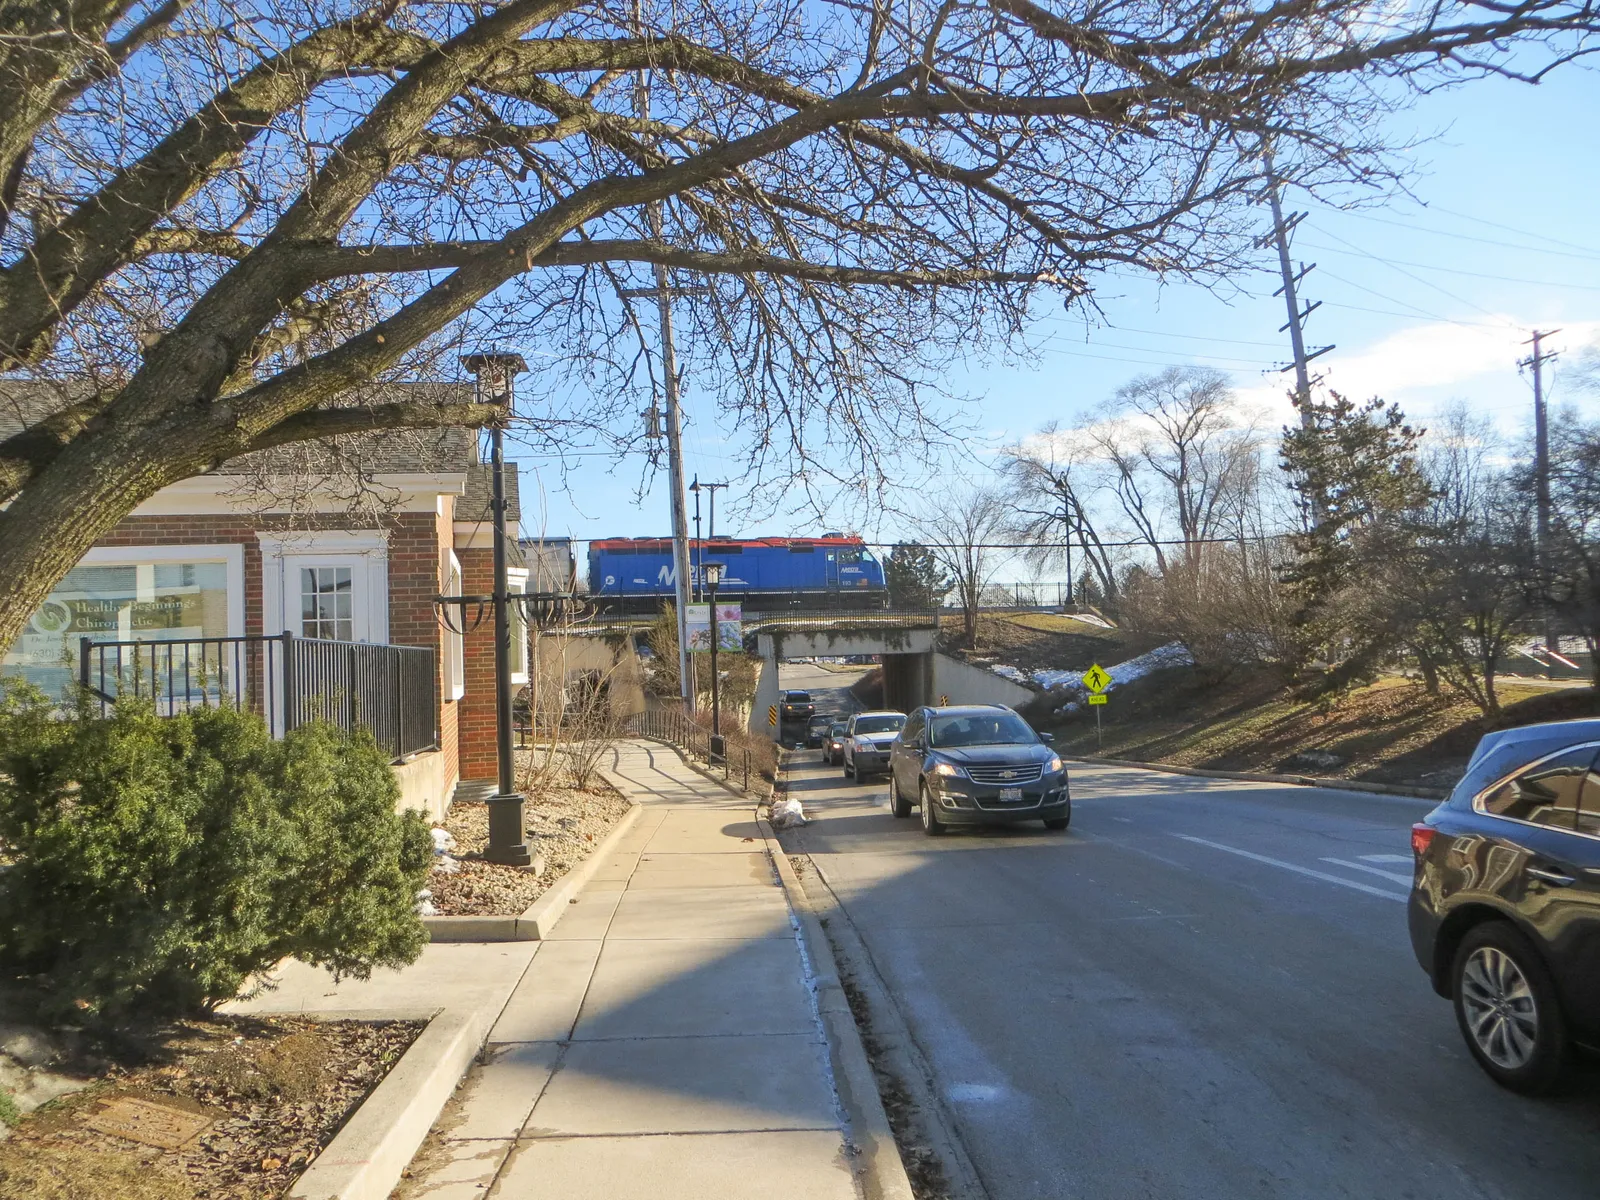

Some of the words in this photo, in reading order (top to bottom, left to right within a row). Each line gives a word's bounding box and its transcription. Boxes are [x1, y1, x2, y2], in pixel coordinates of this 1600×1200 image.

[657, 564, 728, 586] Meta
[76, 600, 123, 614] Healthy
[128, 599, 197, 613] Beginnings
[76, 616, 153, 629] Chiropctic
